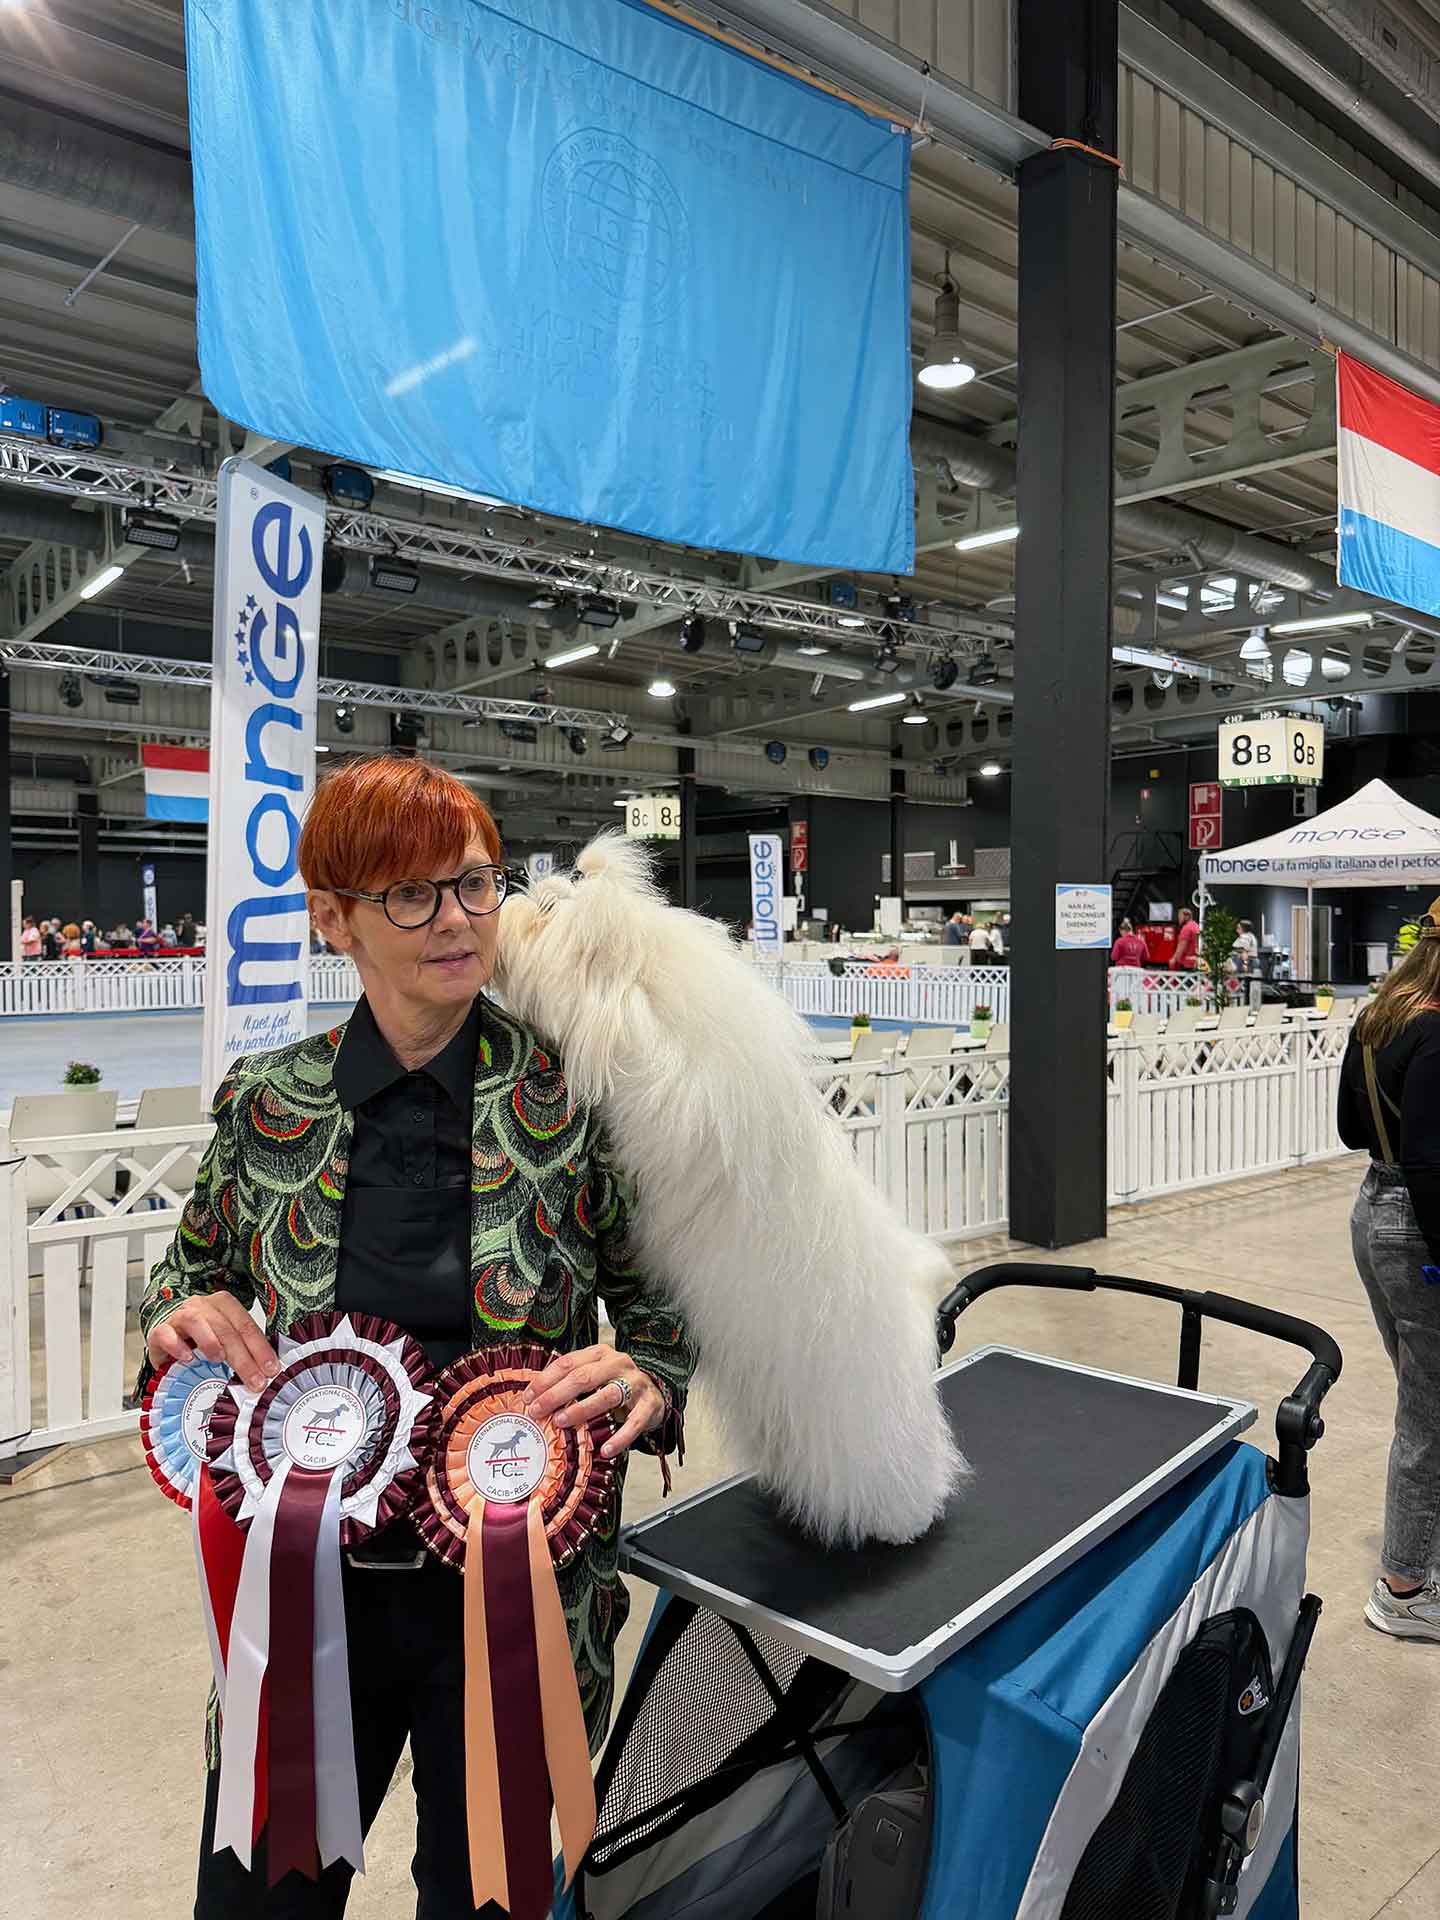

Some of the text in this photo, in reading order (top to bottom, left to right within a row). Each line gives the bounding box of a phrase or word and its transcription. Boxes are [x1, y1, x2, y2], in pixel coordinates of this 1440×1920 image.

[1232, 734, 1271, 765] 8B
[1293, 732, 1315, 765] 8B
[1286, 858, 1331, 872] famiglia
[1335, 856, 1377, 869] italiana
[1379, 856, 1398, 869] del
[1402, 857, 1423, 871] pet
[186, 1384, 213, 1421] INTERNATIONAL
[294, 1389, 341, 1415] INTERNATIONAL
[341, 1393, 354, 1405] DOG
[191, 1440, 204, 1454] Best
[474, 1418, 542, 1450] INTERNATIONAL DOG SHOW
[303, 1455, 327, 1463] CACIB
